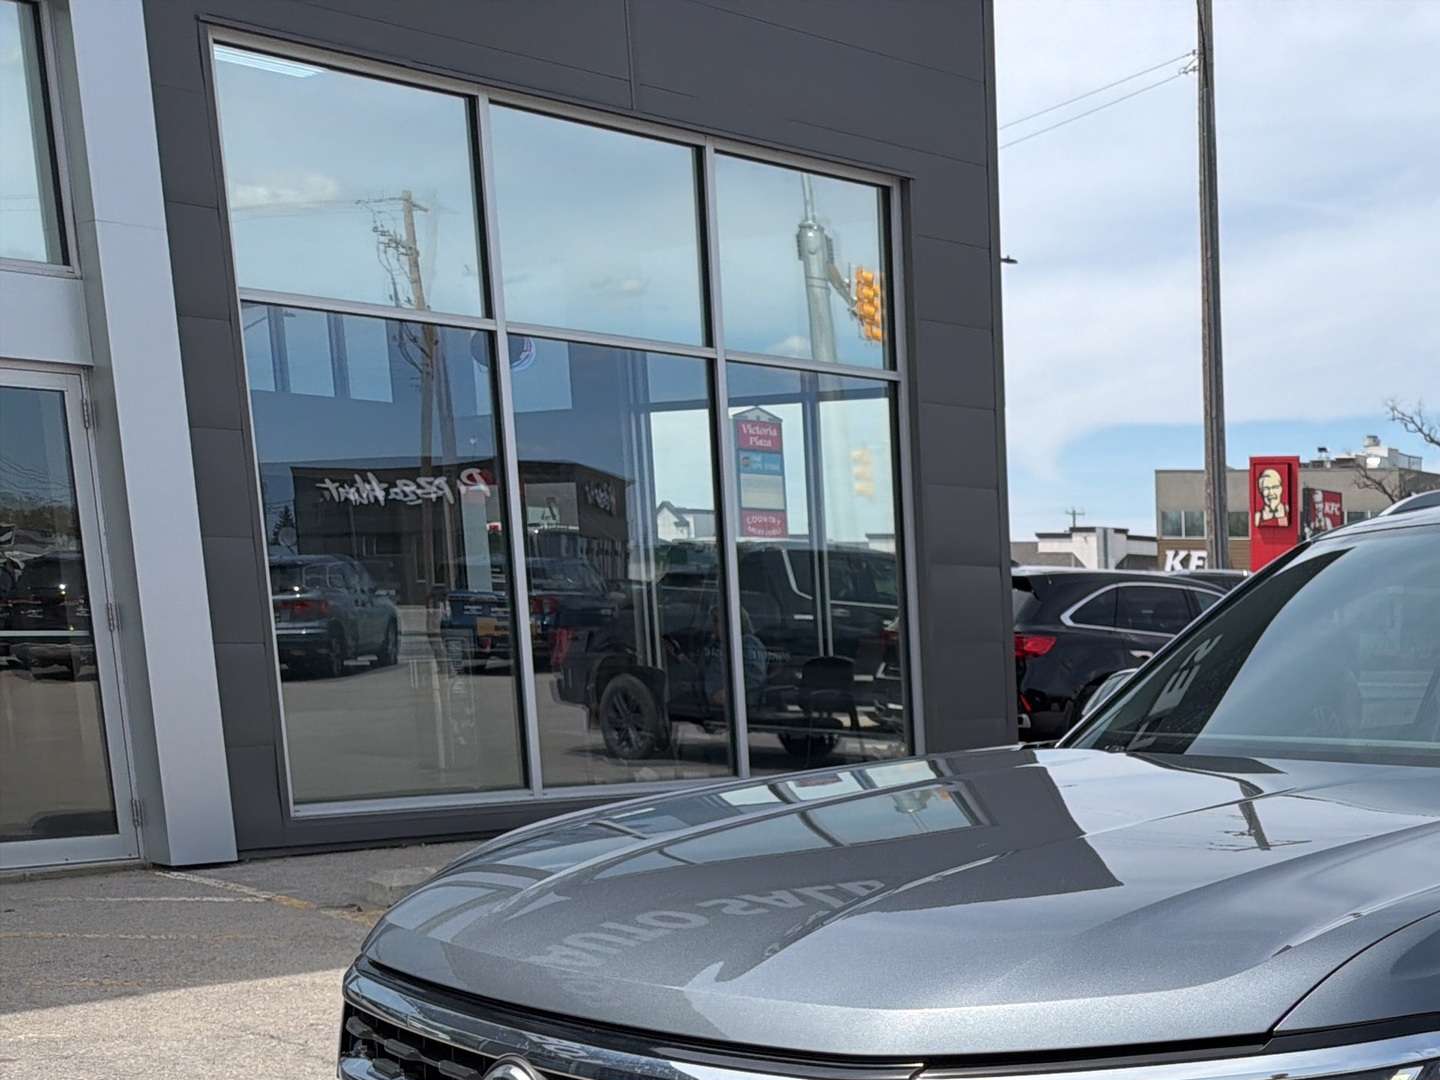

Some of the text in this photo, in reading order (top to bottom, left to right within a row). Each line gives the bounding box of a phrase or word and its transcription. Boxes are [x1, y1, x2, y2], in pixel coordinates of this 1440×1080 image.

[742, 423, 777, 436] Victoria
[750, 436, 772, 447] Plaza
[1323, 501, 1341, 516] KFC
[1164, 549, 1209, 571] KF
